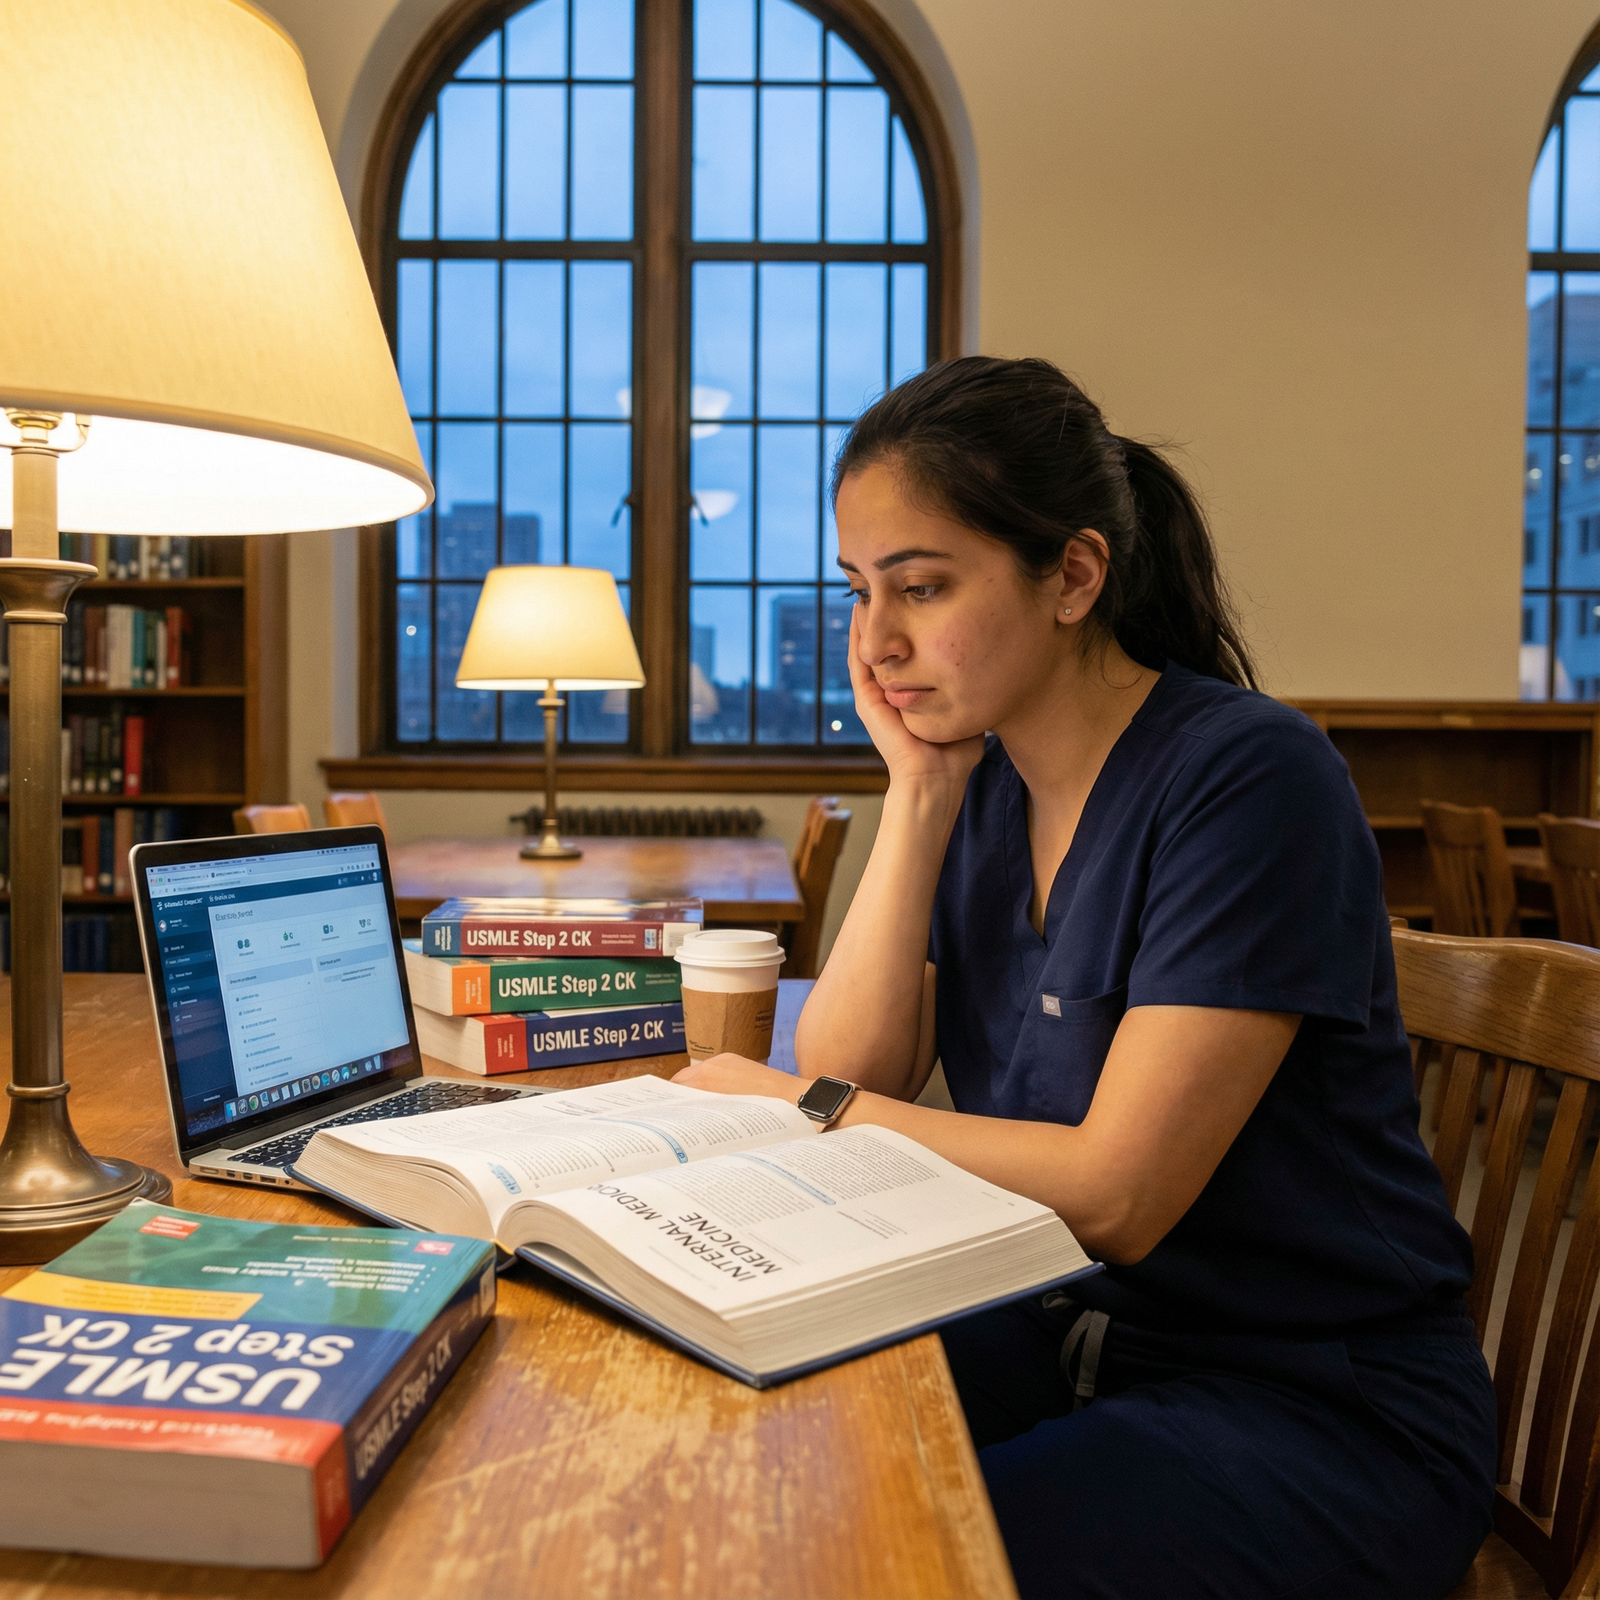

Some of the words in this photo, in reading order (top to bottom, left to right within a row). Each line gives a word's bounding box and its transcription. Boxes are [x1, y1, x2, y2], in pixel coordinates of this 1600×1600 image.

[466, 930, 520, 947] USMLE
[523, 929, 556, 950] Step
[559, 931, 569, 946] 2
[571, 930, 592, 946] CK
[498, 975, 558, 998] USMLE
[561, 975, 598, 997] Step
[601, 973, 611, 991] 2
[614, 971, 637, 990] CK
[533, 1028, 590, 1053] USMLE
[593, 1026, 628, 1048] Step
[631, 1024, 640, 1041] 2
[643, 1020, 665, 1040] CK
[658, 1219, 757, 1282] INTERNAL
[678, 1211, 783, 1275] MEDICINE
[16, 1314, 131, 1350] CK
[132, 1324, 194, 1356] 2
[194, 1323, 355, 1367] Step
[0, 1348, 322, 1411] USMLE
[354, 1397, 402, 1481] USMLE
[435, 1329, 452, 1372] CK
